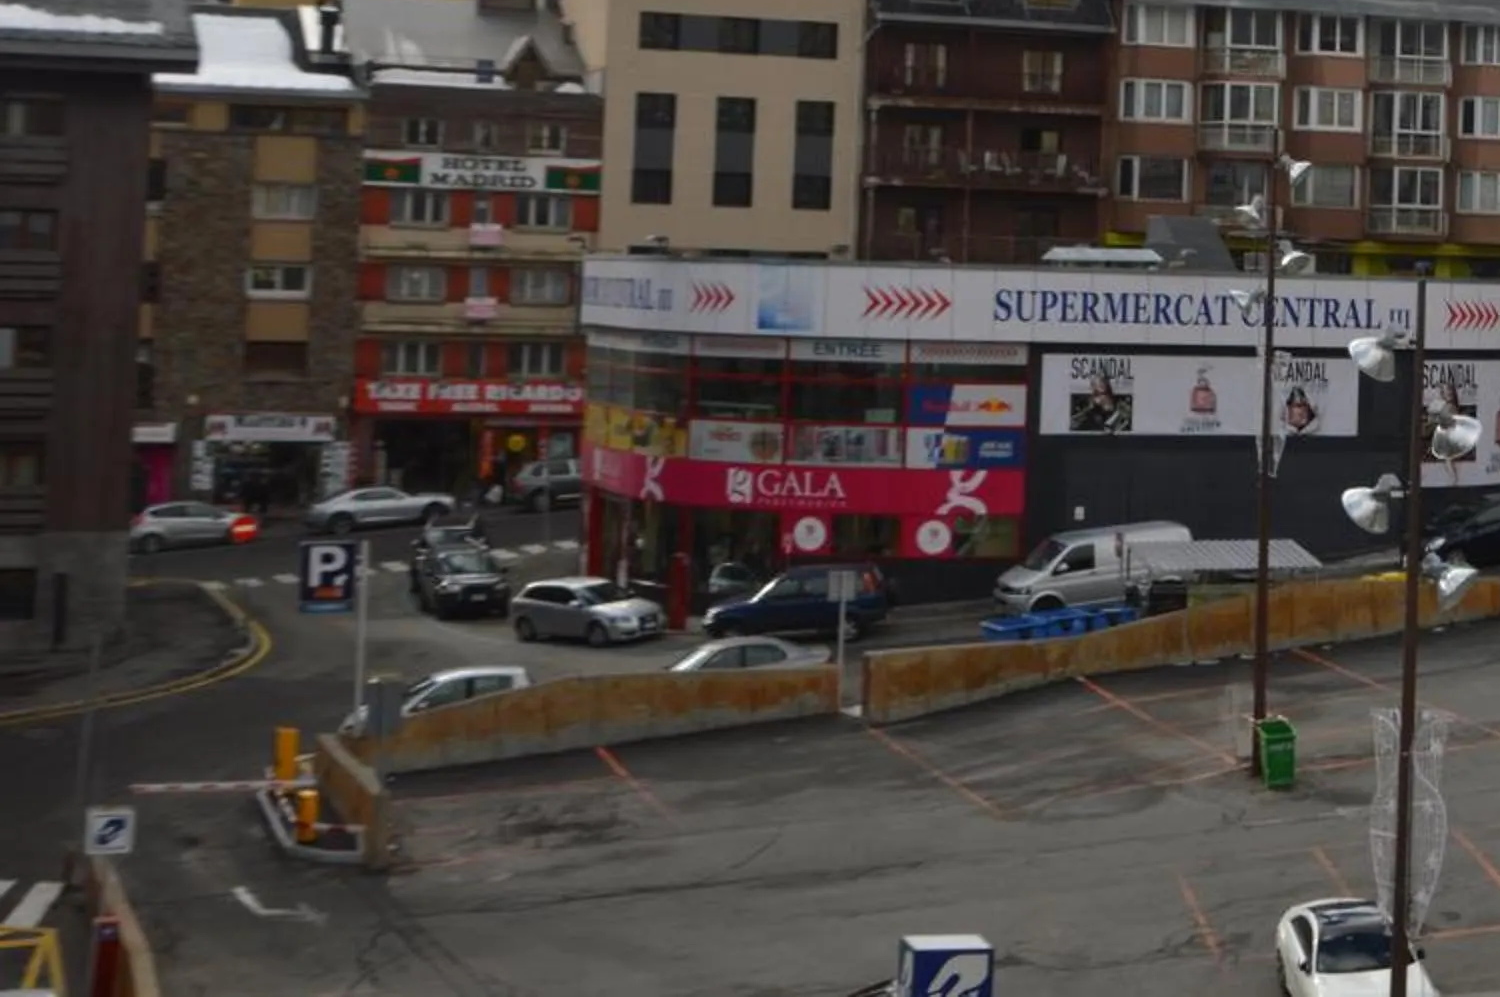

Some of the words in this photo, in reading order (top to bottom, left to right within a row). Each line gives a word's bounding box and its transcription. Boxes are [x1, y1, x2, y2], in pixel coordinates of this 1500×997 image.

[442, 157, 526, 172] HOTEL
[430, 172, 537, 188] MADRID
[993, 289, 1235, 326] SUPERMERCAT
[1071, 356, 1134, 380] SCANDAL
[757, 469, 846, 498] GALA
